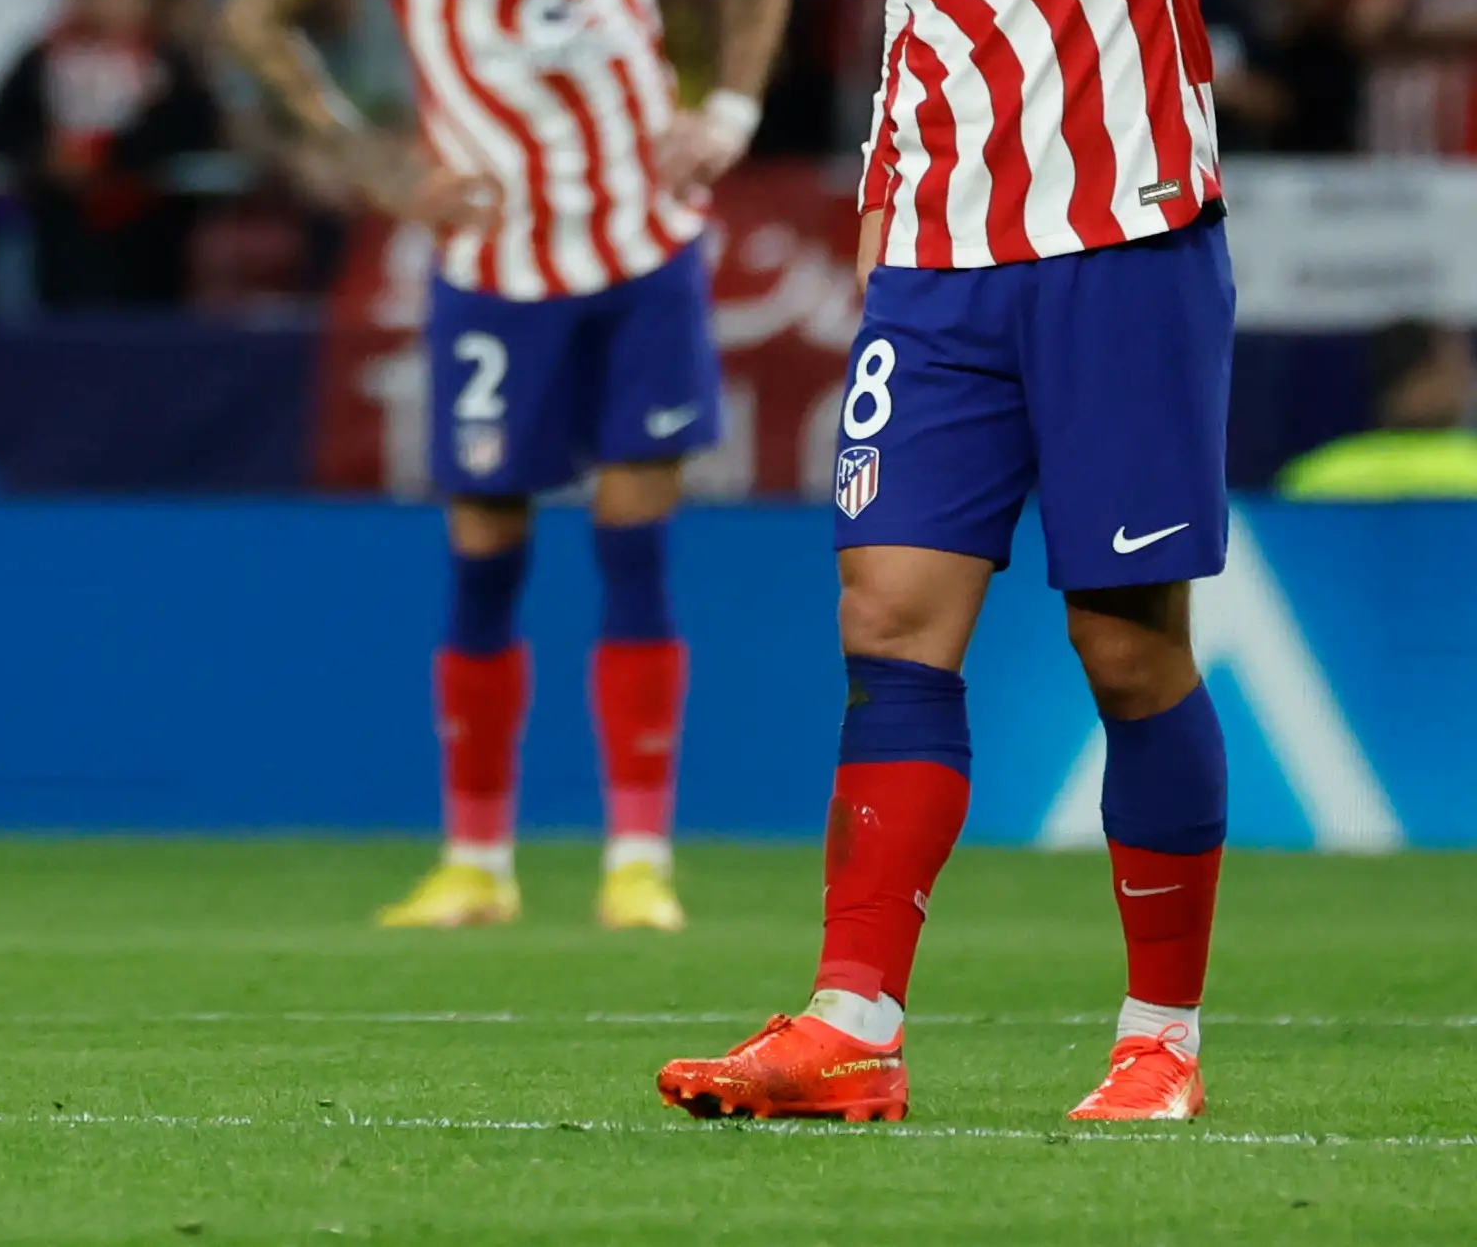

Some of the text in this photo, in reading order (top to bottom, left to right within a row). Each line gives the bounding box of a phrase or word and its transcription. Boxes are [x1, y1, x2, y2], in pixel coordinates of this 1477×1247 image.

[453, 328, 509, 421] 2
[844, 338, 896, 440] 8
[820, 1058, 882, 1079] ULTRA
